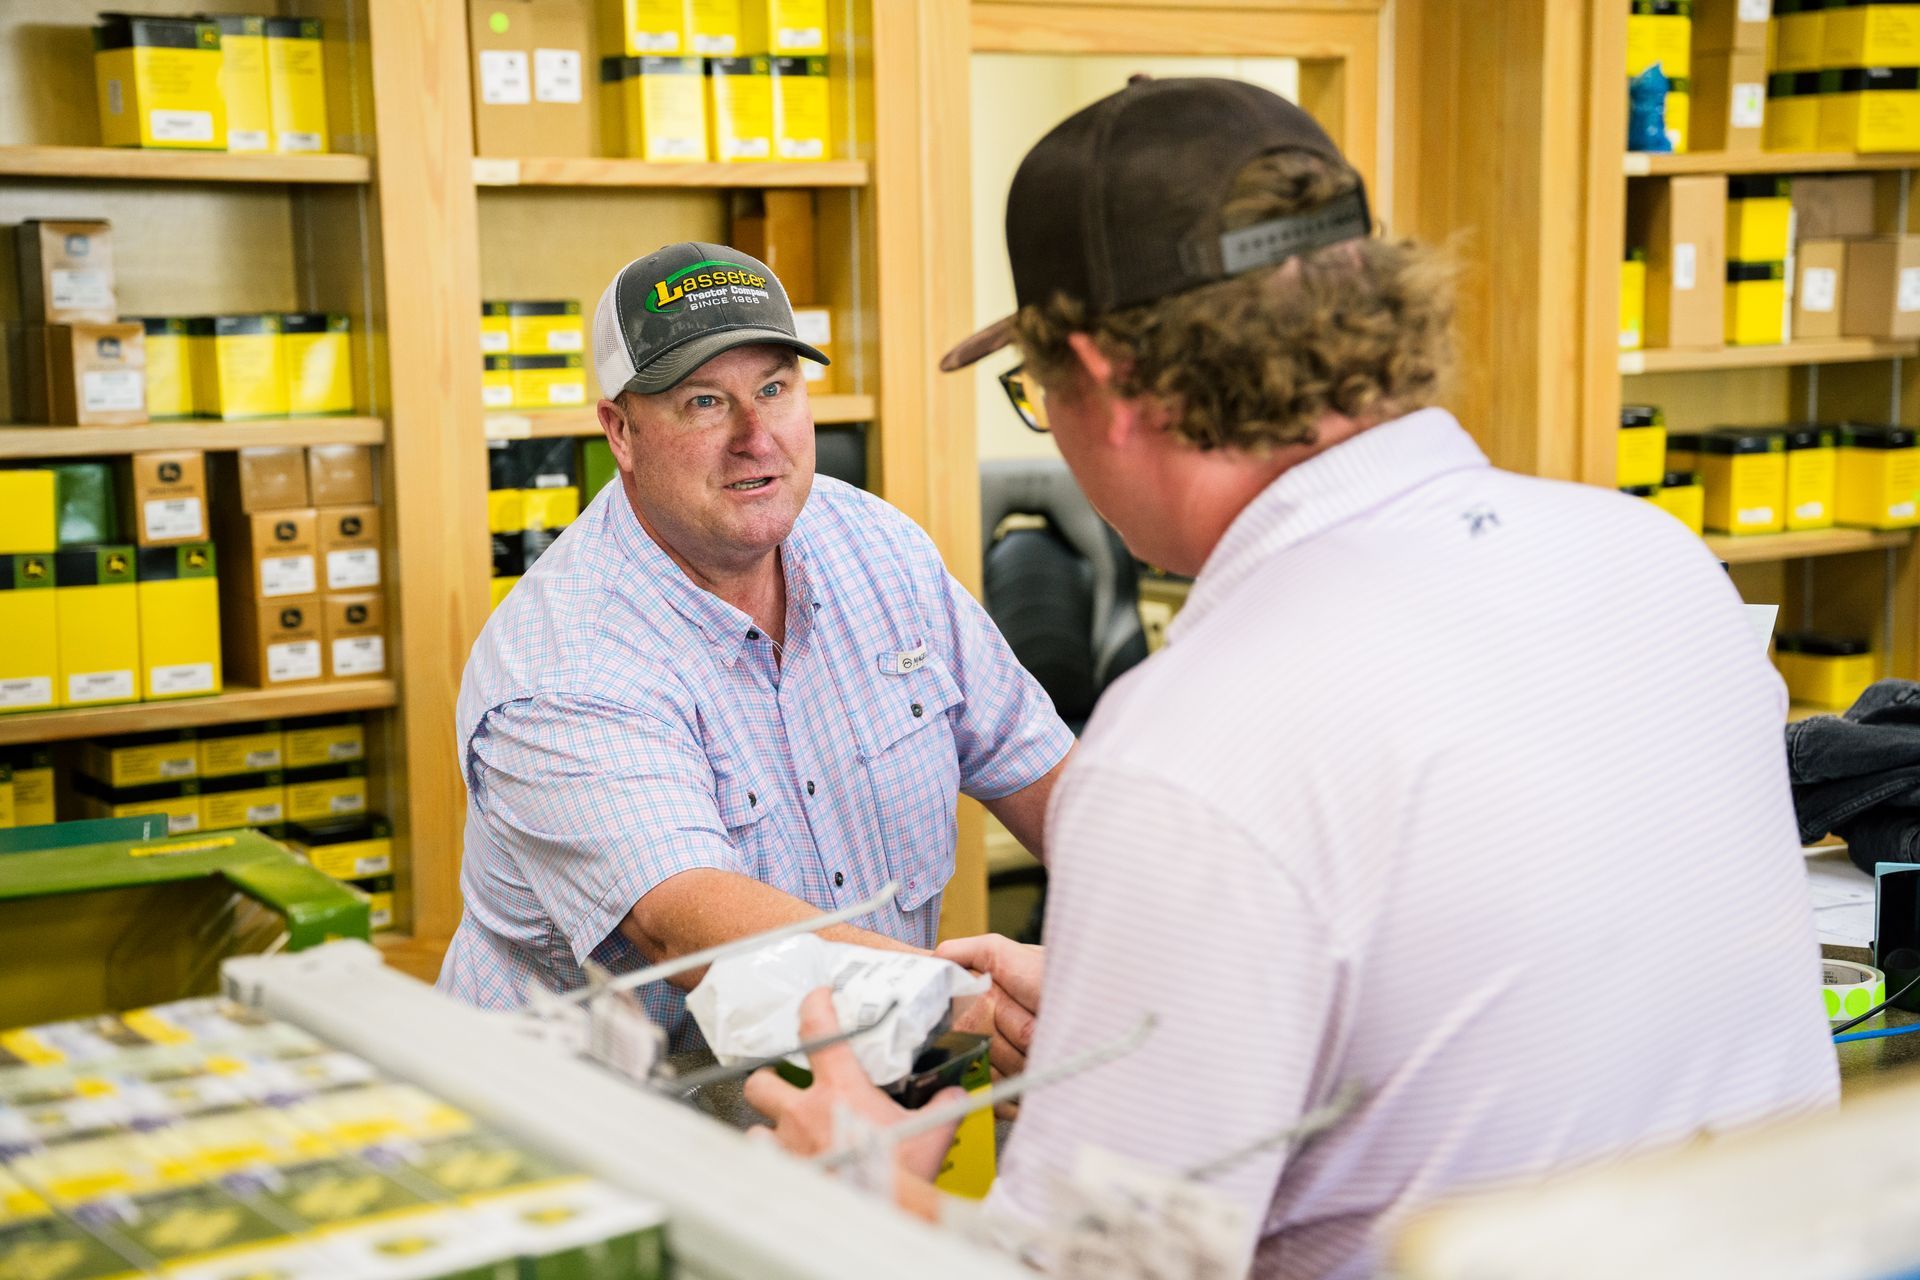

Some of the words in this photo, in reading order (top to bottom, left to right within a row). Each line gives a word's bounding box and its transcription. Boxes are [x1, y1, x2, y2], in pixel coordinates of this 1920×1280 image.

[655, 270, 766, 307] Lasseter
[685, 287, 728, 303] Tractor
[730, 285, 769, 300] Company
[690, 297, 729, 311] SINCE
